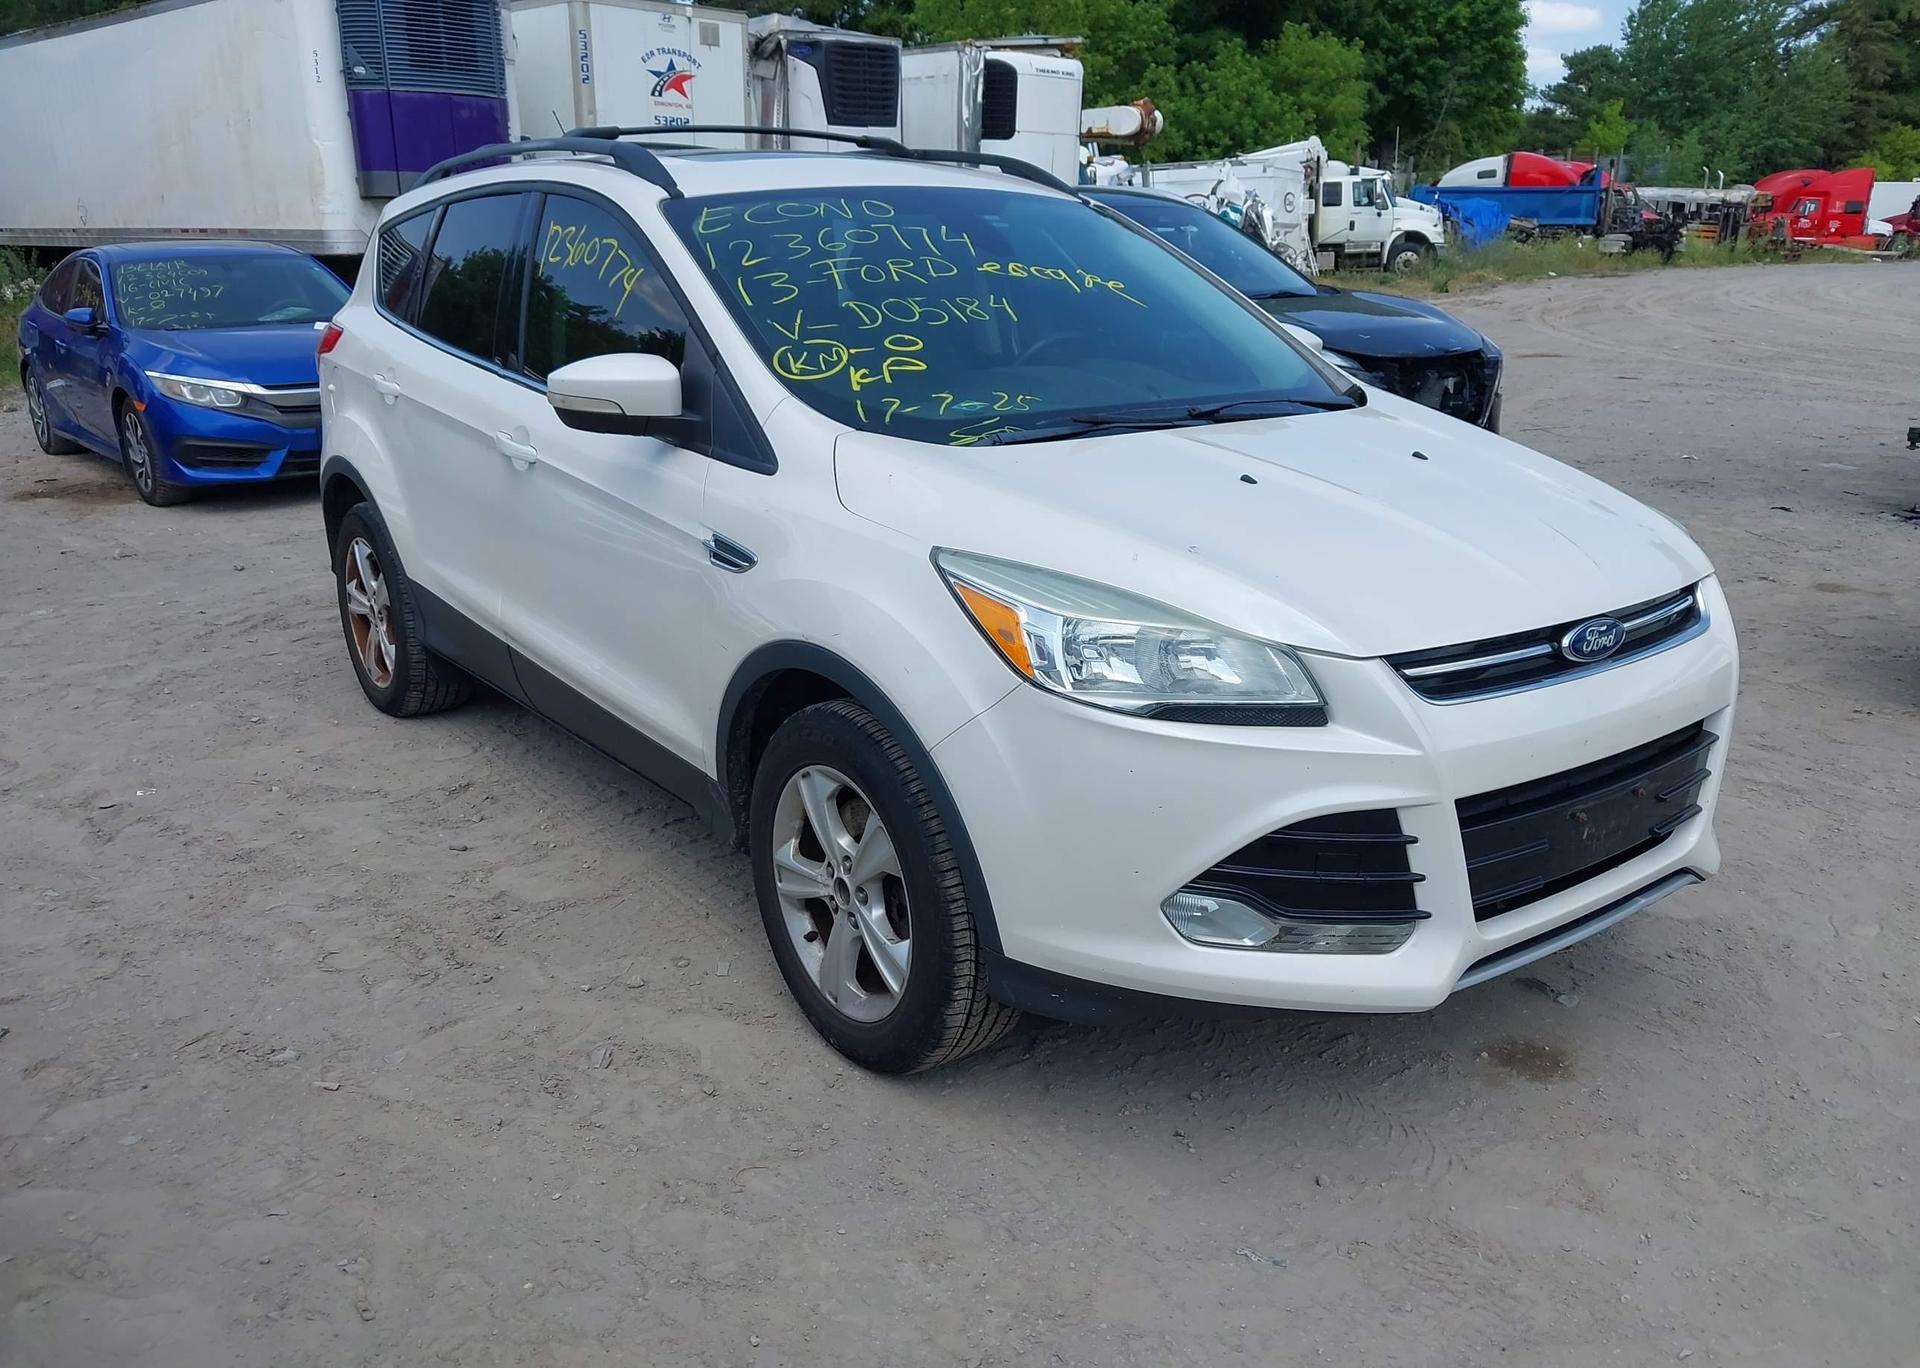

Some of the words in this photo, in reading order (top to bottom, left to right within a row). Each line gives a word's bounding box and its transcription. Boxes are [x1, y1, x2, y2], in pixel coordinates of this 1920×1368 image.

[578, 29, 590, 85] 53202
[656, 47, 702, 70] TRANSPORT
[654, 114, 691, 128] 53202
[1583, 624, 1617, 654] Ford
